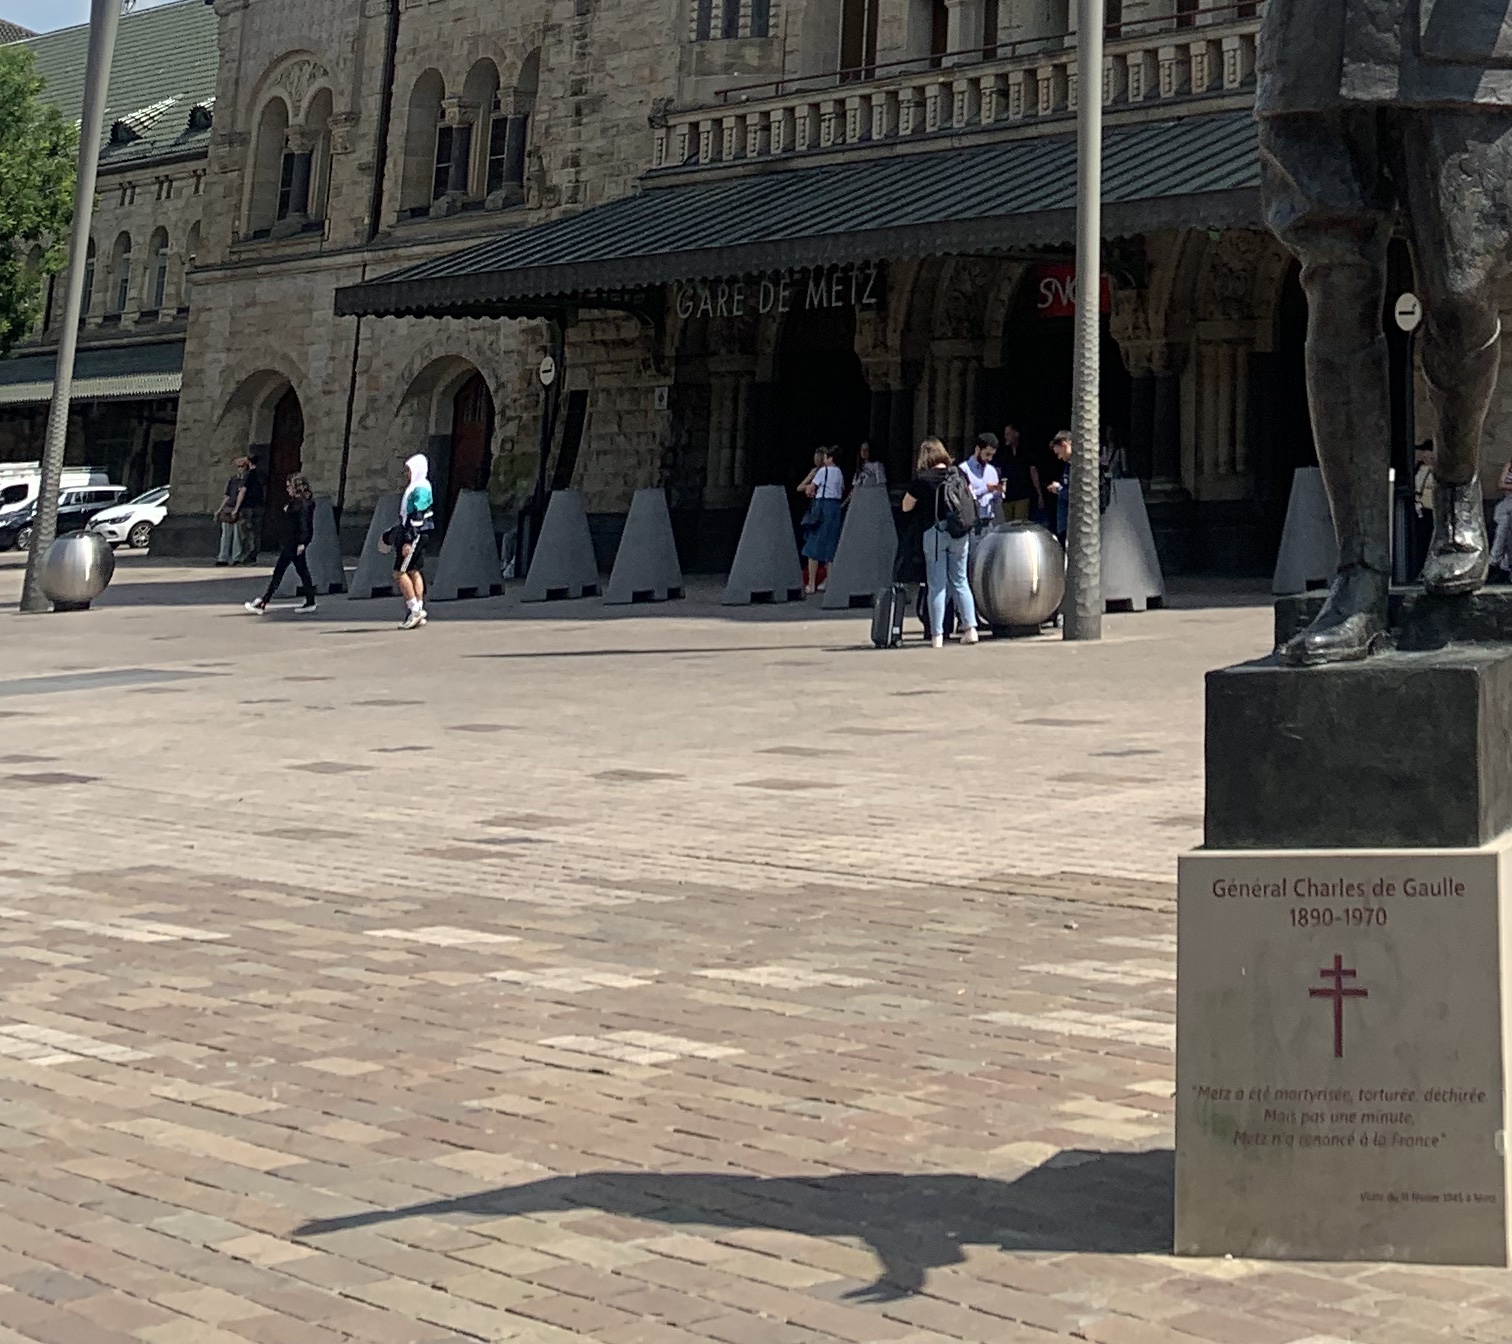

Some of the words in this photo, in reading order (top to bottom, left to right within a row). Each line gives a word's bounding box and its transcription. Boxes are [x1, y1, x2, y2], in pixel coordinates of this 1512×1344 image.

[676, 282, 745, 319] GARE
[758, 279, 790, 314] DE
[805, 269, 878, 310] METZ
[1212, 877, 1287, 898] Général
[1293, 877, 1364, 898] Charles
[1372, 877, 1396, 897] de
[1403, 877, 1466, 897] Gaulle
[1290, 907, 1387, 928] 1890-1970
[1235, 1086, 1245, 1100] a
[1248, 1085, 1272, 1101] été
[1264, 1109, 1296, 1123] Mais
[1300, 1111, 1325, 1126] pas
[1330, 1112, 1356, 1124] une
[1233, 1130, 1266, 1145] Metz
[1299, 1132, 1355, 1146] renoncé
[1373, 1131, 1386, 1146] la
